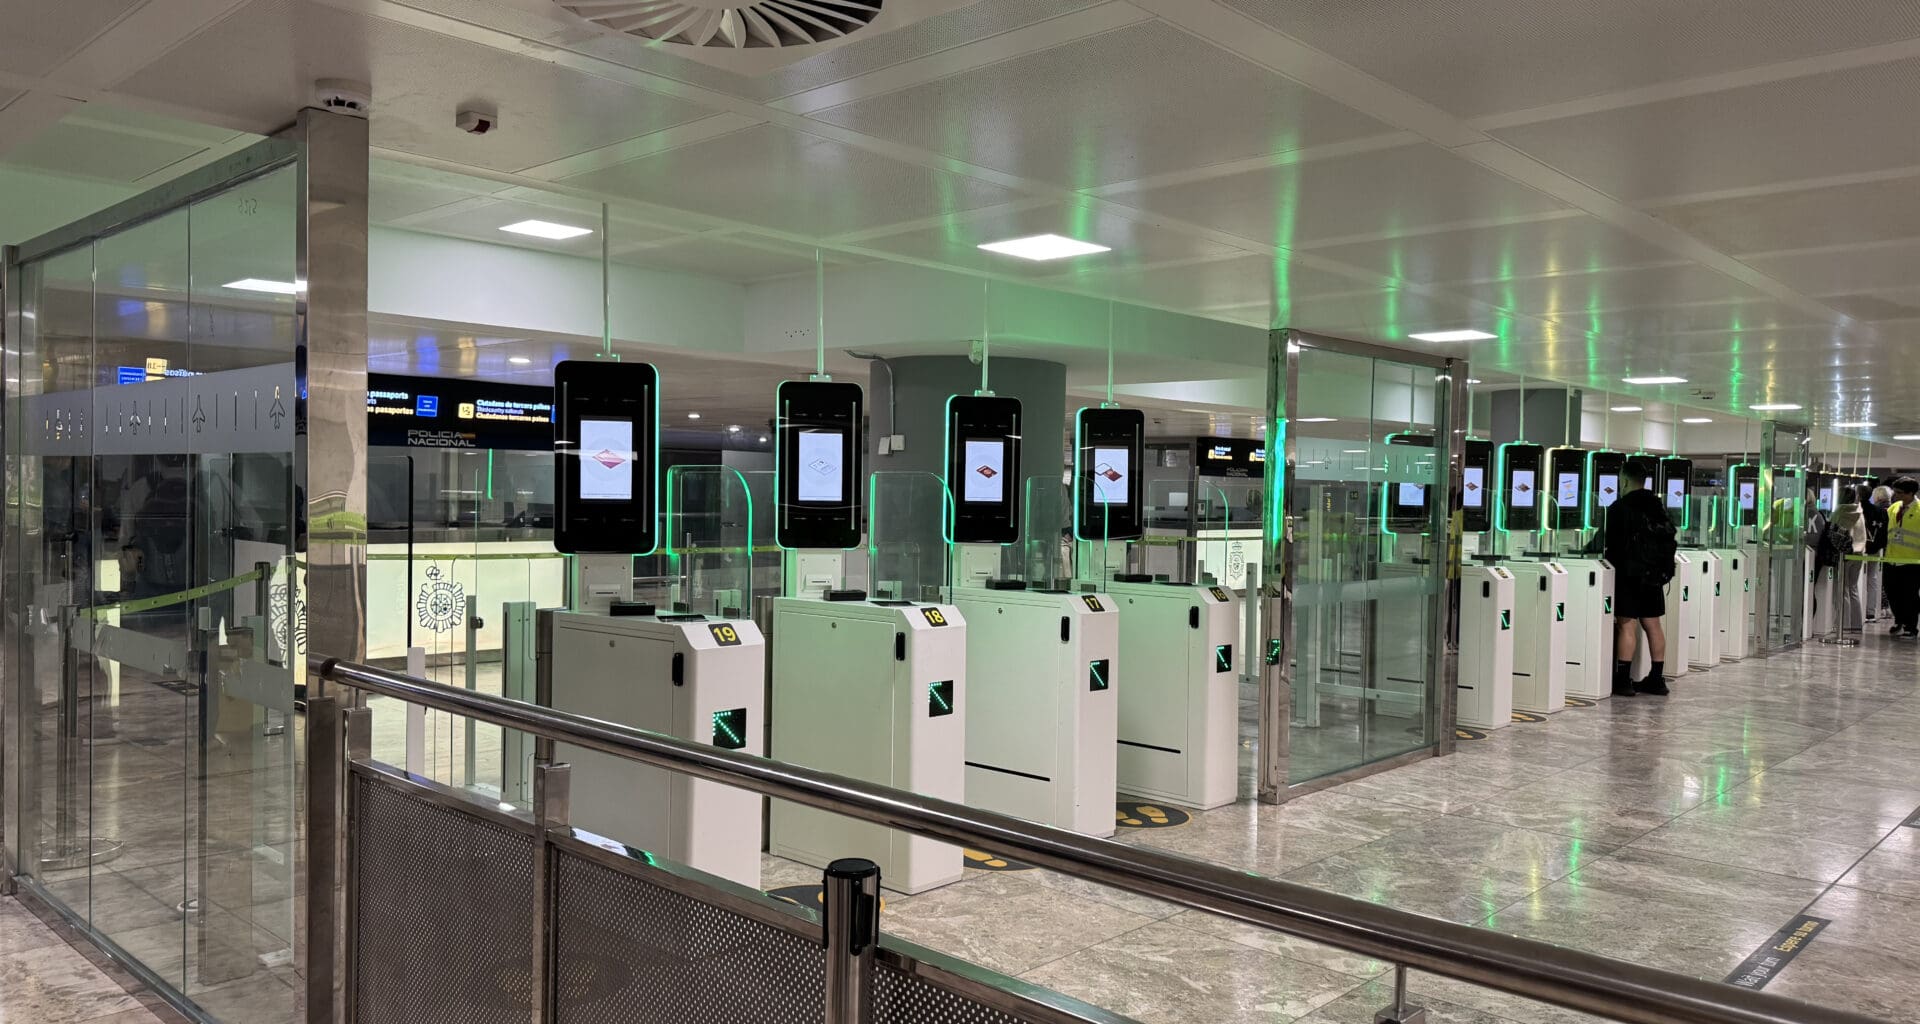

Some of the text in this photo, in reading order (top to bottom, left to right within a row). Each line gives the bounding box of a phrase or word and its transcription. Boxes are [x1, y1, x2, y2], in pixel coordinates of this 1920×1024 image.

[408, 430, 463, 439] POLICIA
[408, 438, 476, 447] NACIONAL
[1085, 597, 1100, 609] 17
[925, 610, 944, 624] 18
[713, 626, 736, 642] 19
